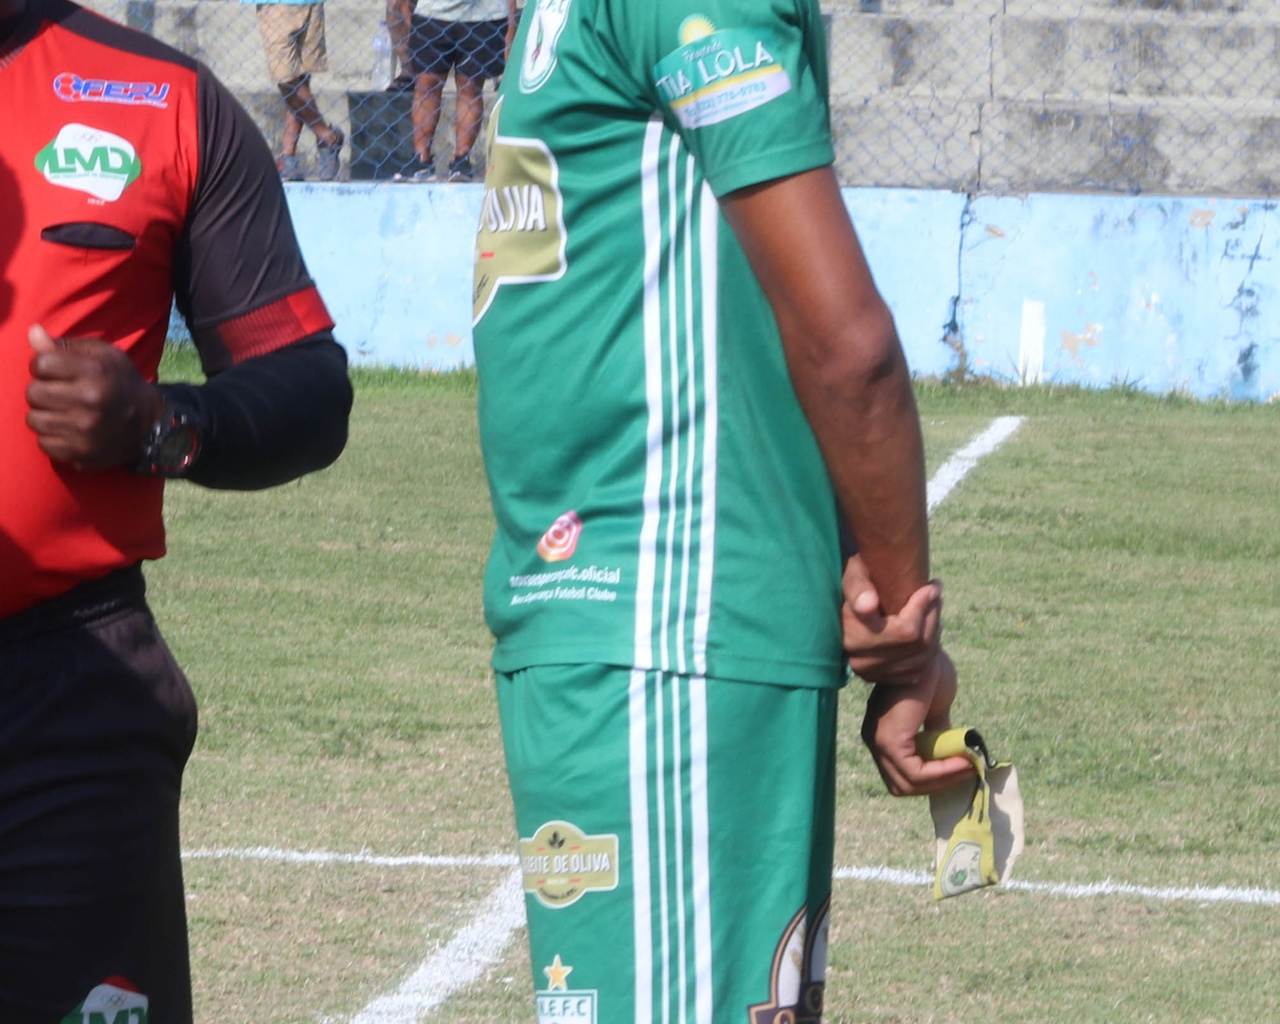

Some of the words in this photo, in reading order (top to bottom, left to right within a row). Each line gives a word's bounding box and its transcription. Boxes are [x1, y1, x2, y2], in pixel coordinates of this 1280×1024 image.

[655, 69, 693, 100] TIA
[697, 40, 774, 84] LOLA
[80, 80, 170, 102] FERJ
[44, 144, 133, 175] LMD
[553, 854, 569, 874] DE
[571, 852, 611, 873] OLIVA
